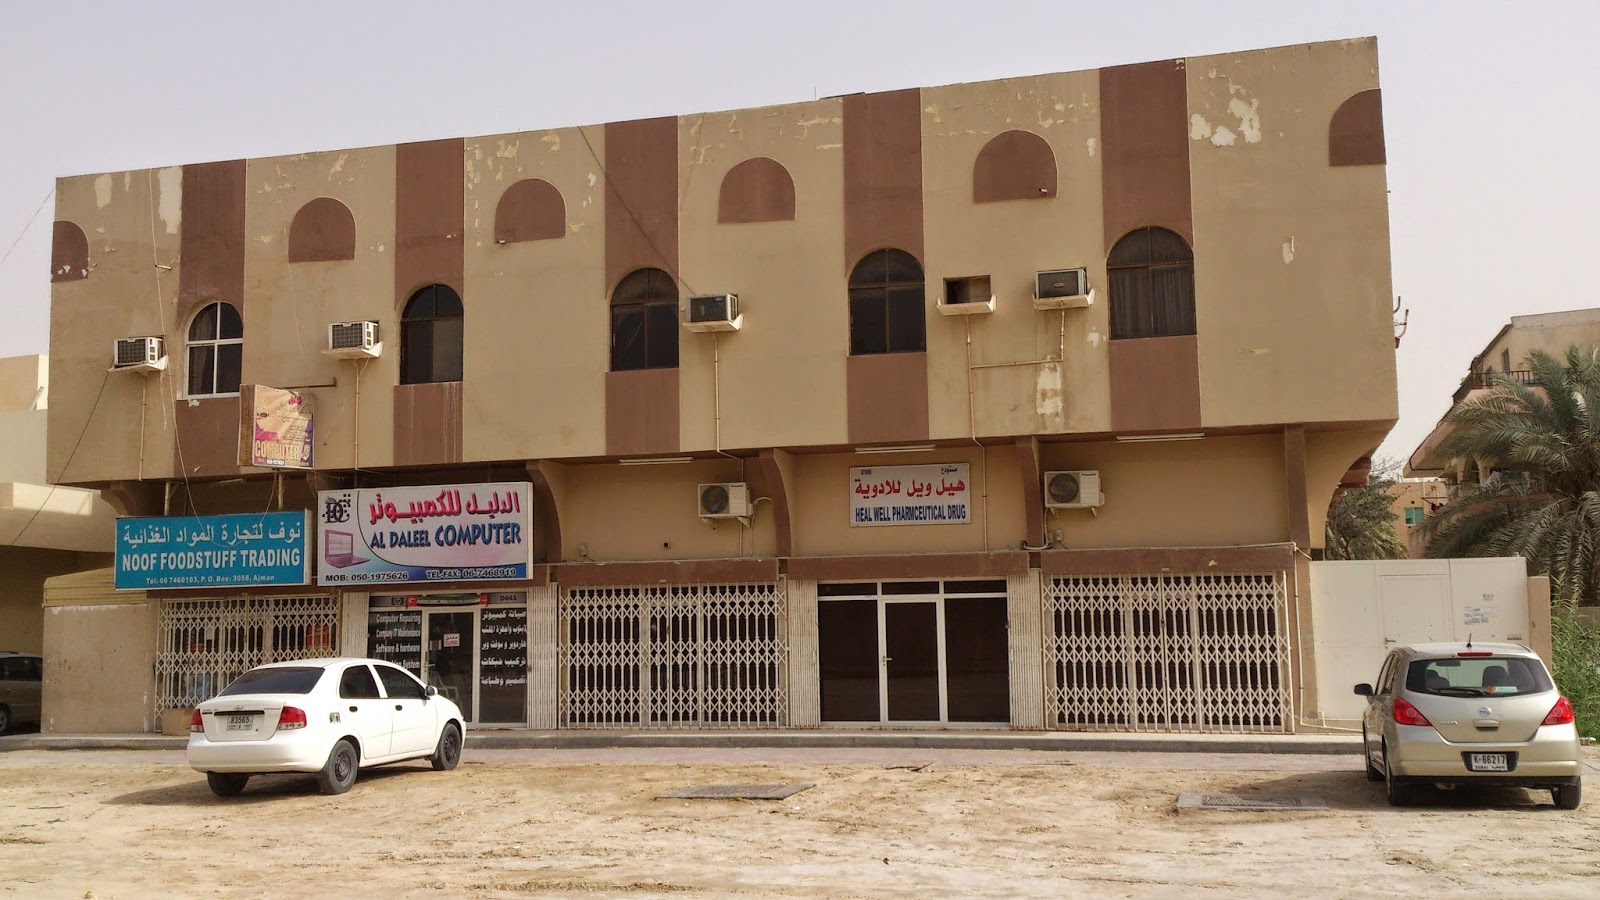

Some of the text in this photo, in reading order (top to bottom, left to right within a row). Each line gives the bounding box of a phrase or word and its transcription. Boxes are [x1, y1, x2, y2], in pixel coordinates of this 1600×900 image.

[255, 440, 299, 460] COMPUTER
[941, 465, 957, 474] مستودع
[854, 478, 966, 499] هيل ويل للادوية
[369, 489, 520, 525] الدليل للكمبيوتر
[855, 504, 966, 522] HEAL WELL PHARMCEUTICAL DRUG
[123, 521, 301, 549] نوف لتجارة المواد الغذائية
[369, 522, 522, 549] AL DALEEL COMPUTER
[122, 548, 300, 571] NOOF FOODSTUFF TRADING
[253, 574, 275, 582] Ajman
[351, 571, 408, 580] 050-1975626
[426, 568, 516, 578] TEL-FAX: 06-7468919
[376, 613, 421, 624] Computer Repairing
[508, 609, 527, 619] صيانة
[376, 629, 393, 639] Company
[375, 643, 420, 653] Software & hardware
[402, 659, 420, 669] System
[504, 657, 526, 667] تركيب
[480, 675, 527, 688] تصميم وطباعة
[230, 716, 250, 724] 83565
